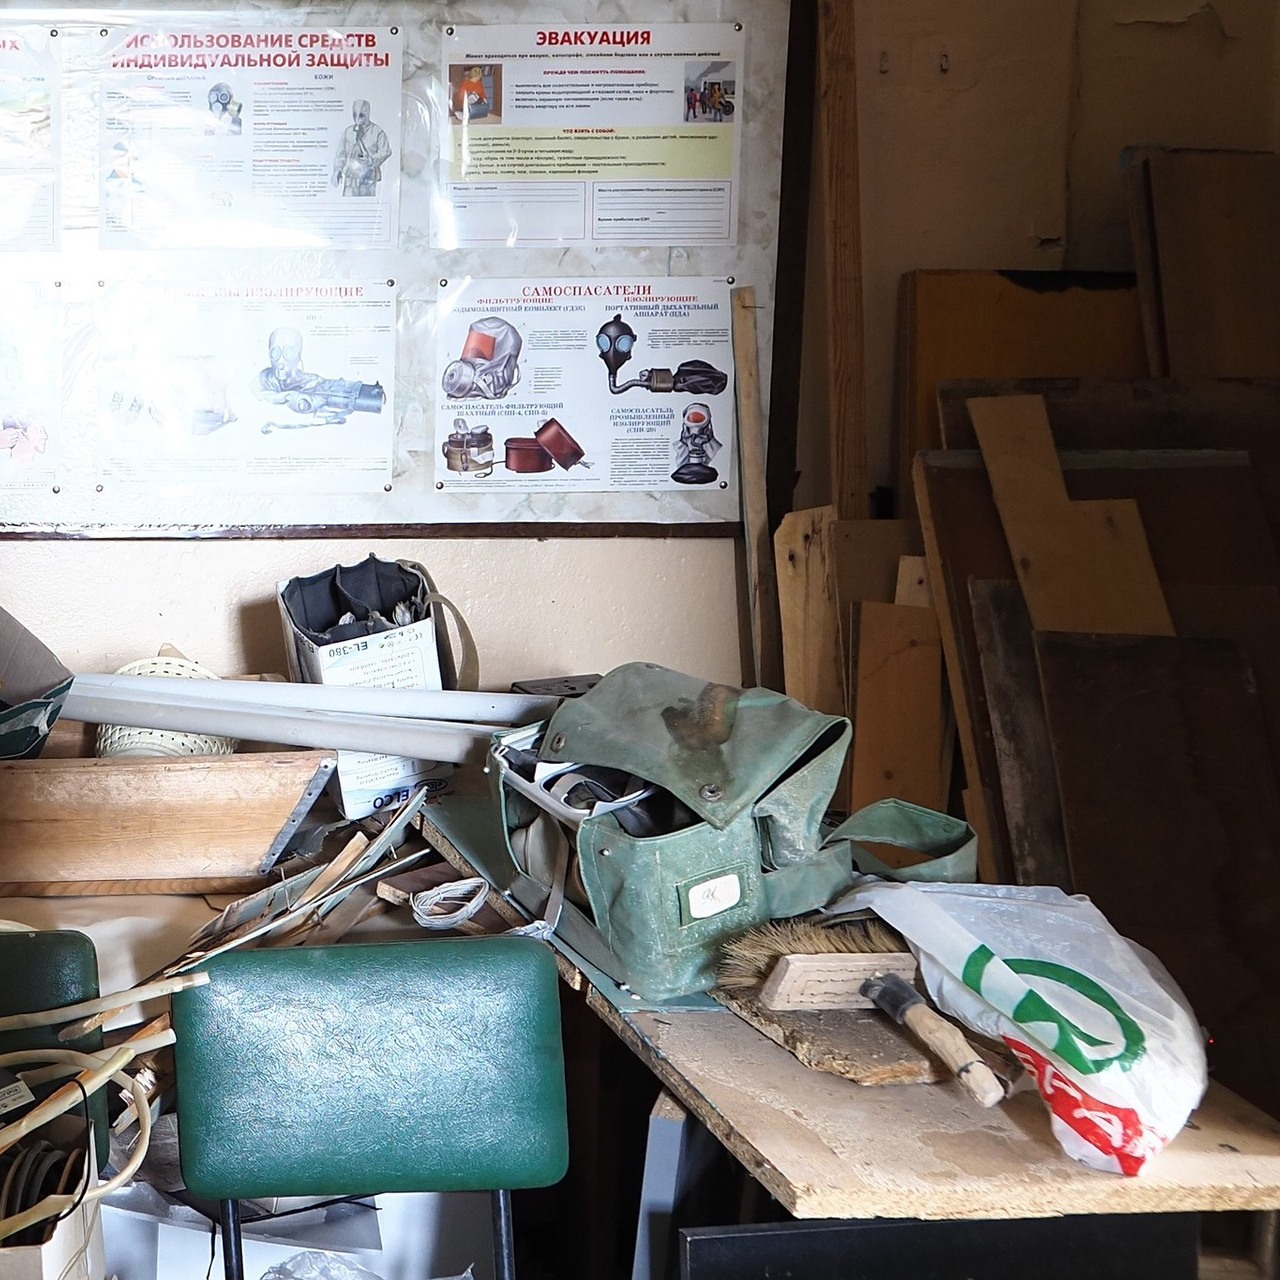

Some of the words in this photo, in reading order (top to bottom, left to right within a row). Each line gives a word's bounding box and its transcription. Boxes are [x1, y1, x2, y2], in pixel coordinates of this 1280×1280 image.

[125, 33, 293, 49] ИСОЛЬЗОВАНИЕ
[297, 33, 377, 50] СРЕДСТВ
[536, 30, 651, 47] ЭВАКУАЦИЯ
[111, 50, 300, 70] ИНДИВИДУАЛЬНОЙ
[305, 52, 390, 70] ЗАЩИТЫ
[245, 286, 364, 298] ИЗОЛИРУЮЩИЕ
[522, 285, 653, 297] САМОСПАСАТЕЛИ
[477, 297, 554, 305] ФИЛЬТРУЮЩИЕ
[660, 303, 719, 311] ДЫХАТЕЛЬНЫЙ
[524, 305, 562, 313] КОМПЛЕКТ
[504, 402, 564, 410] ФИЛЬТРУЮЩИЙ
[329, 641, 368, 658] EL-380
[373, 789, 410, 810] ELCO
